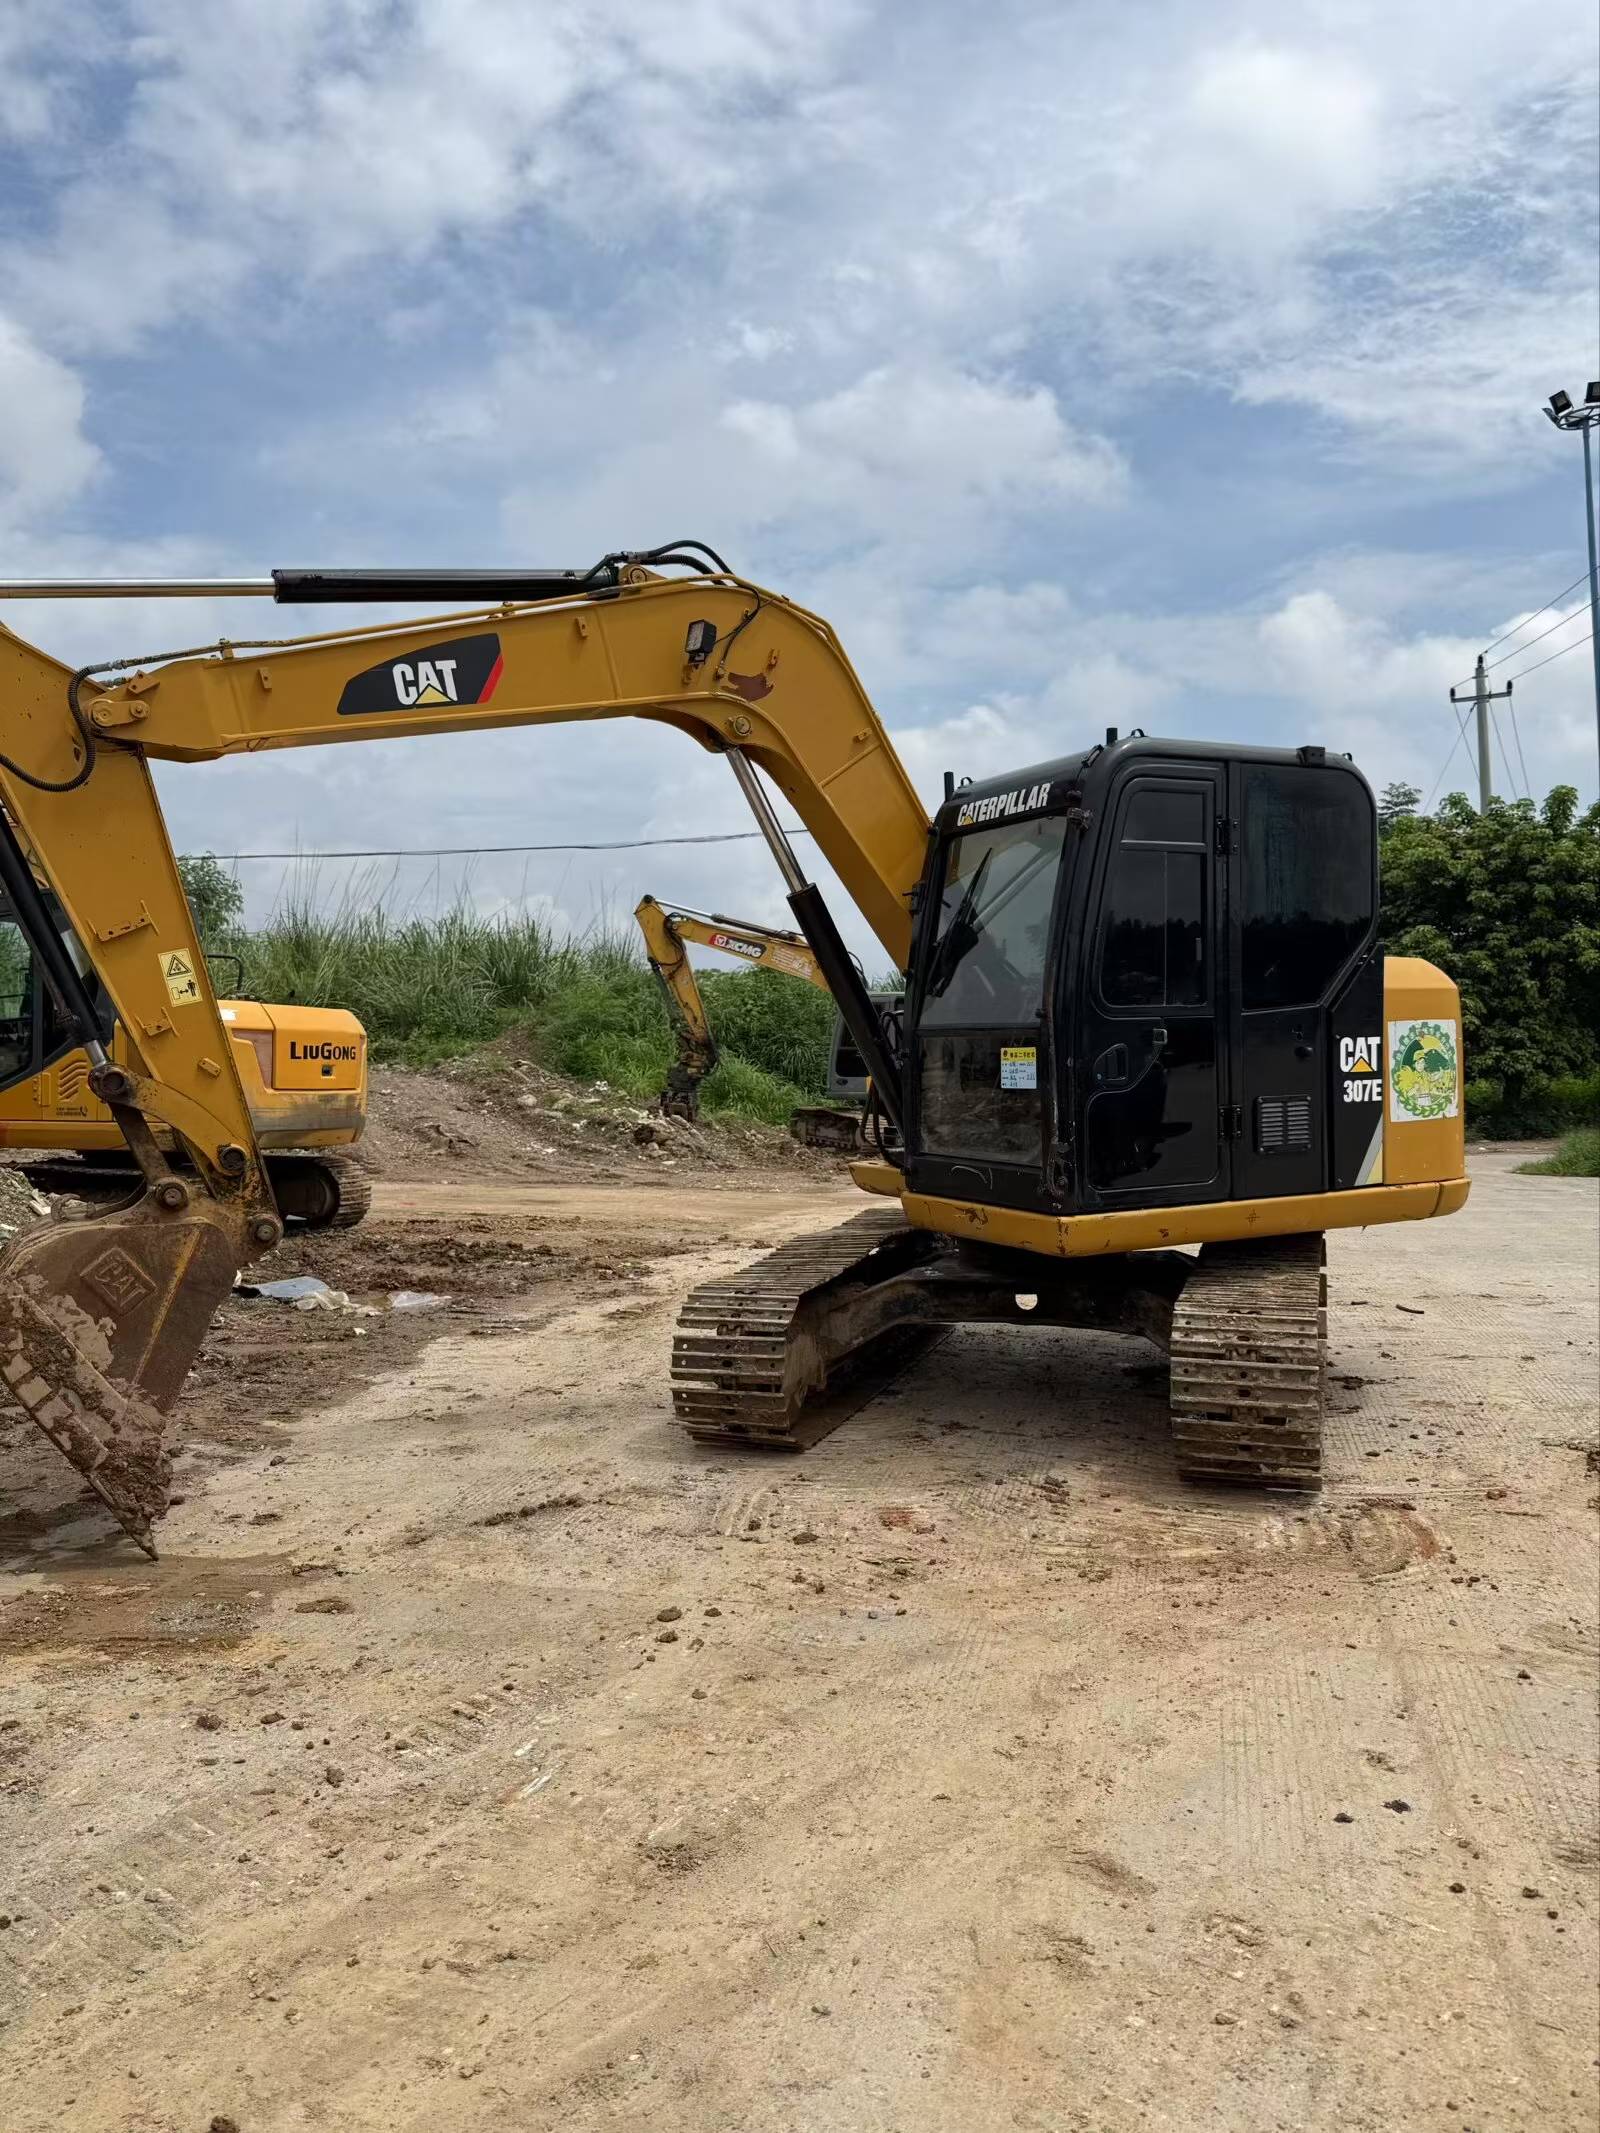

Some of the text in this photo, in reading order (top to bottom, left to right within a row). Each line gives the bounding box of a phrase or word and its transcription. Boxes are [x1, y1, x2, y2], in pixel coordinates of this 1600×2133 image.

[393, 659, 458, 705] CAT
[957, 783, 1051, 826] CATERPILLAR
[726, 939, 762, 958] XCMG
[1340, 1036, 1381, 1073] CAT
[1343, 1079, 1382, 1103] 307E
[94, 1256, 147, 1308] CAT
